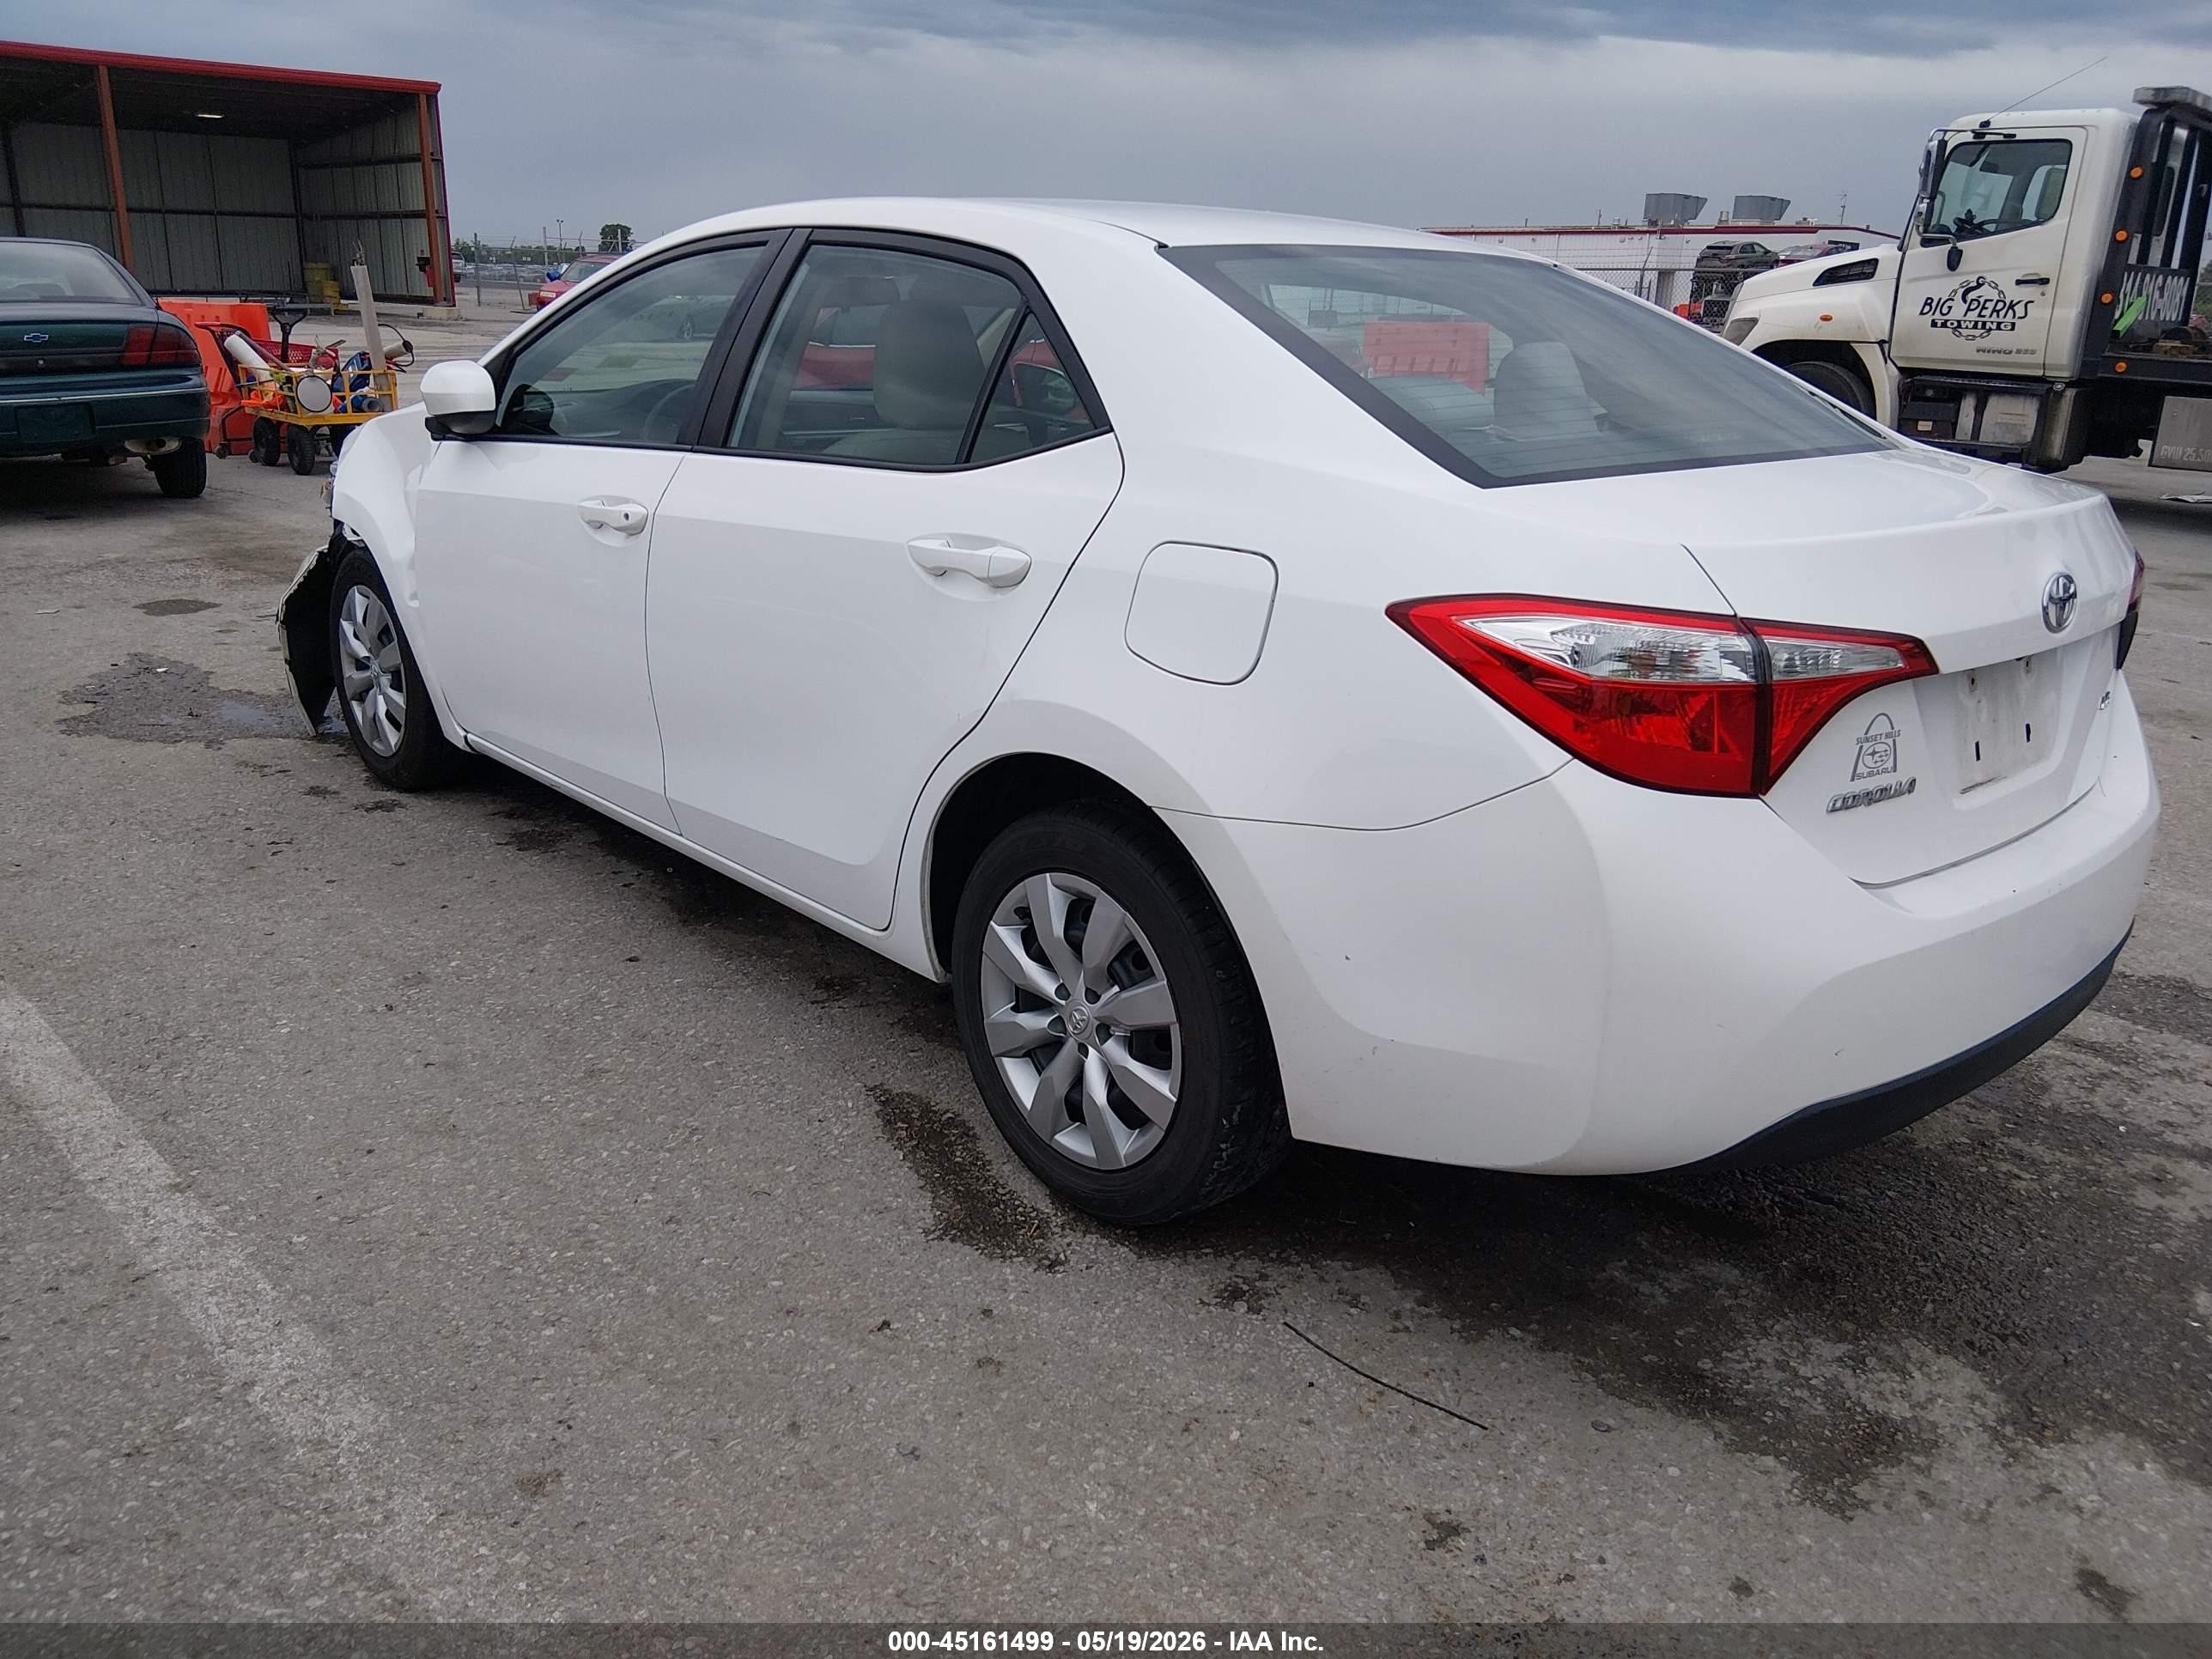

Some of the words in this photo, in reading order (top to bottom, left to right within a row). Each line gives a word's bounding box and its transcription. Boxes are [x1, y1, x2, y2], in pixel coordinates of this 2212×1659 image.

[1919, 297, 1955, 316] BIG
[1963, 298, 2035, 319] PERKS
[1934, 319, 2013, 331] TOWING
[1855, 732, 1883, 745] SUNSET
[1884, 729, 1901, 740] HILLS
[1855, 767, 1893, 781] SUBARU
[1826, 776, 1917, 814] COROLLA
